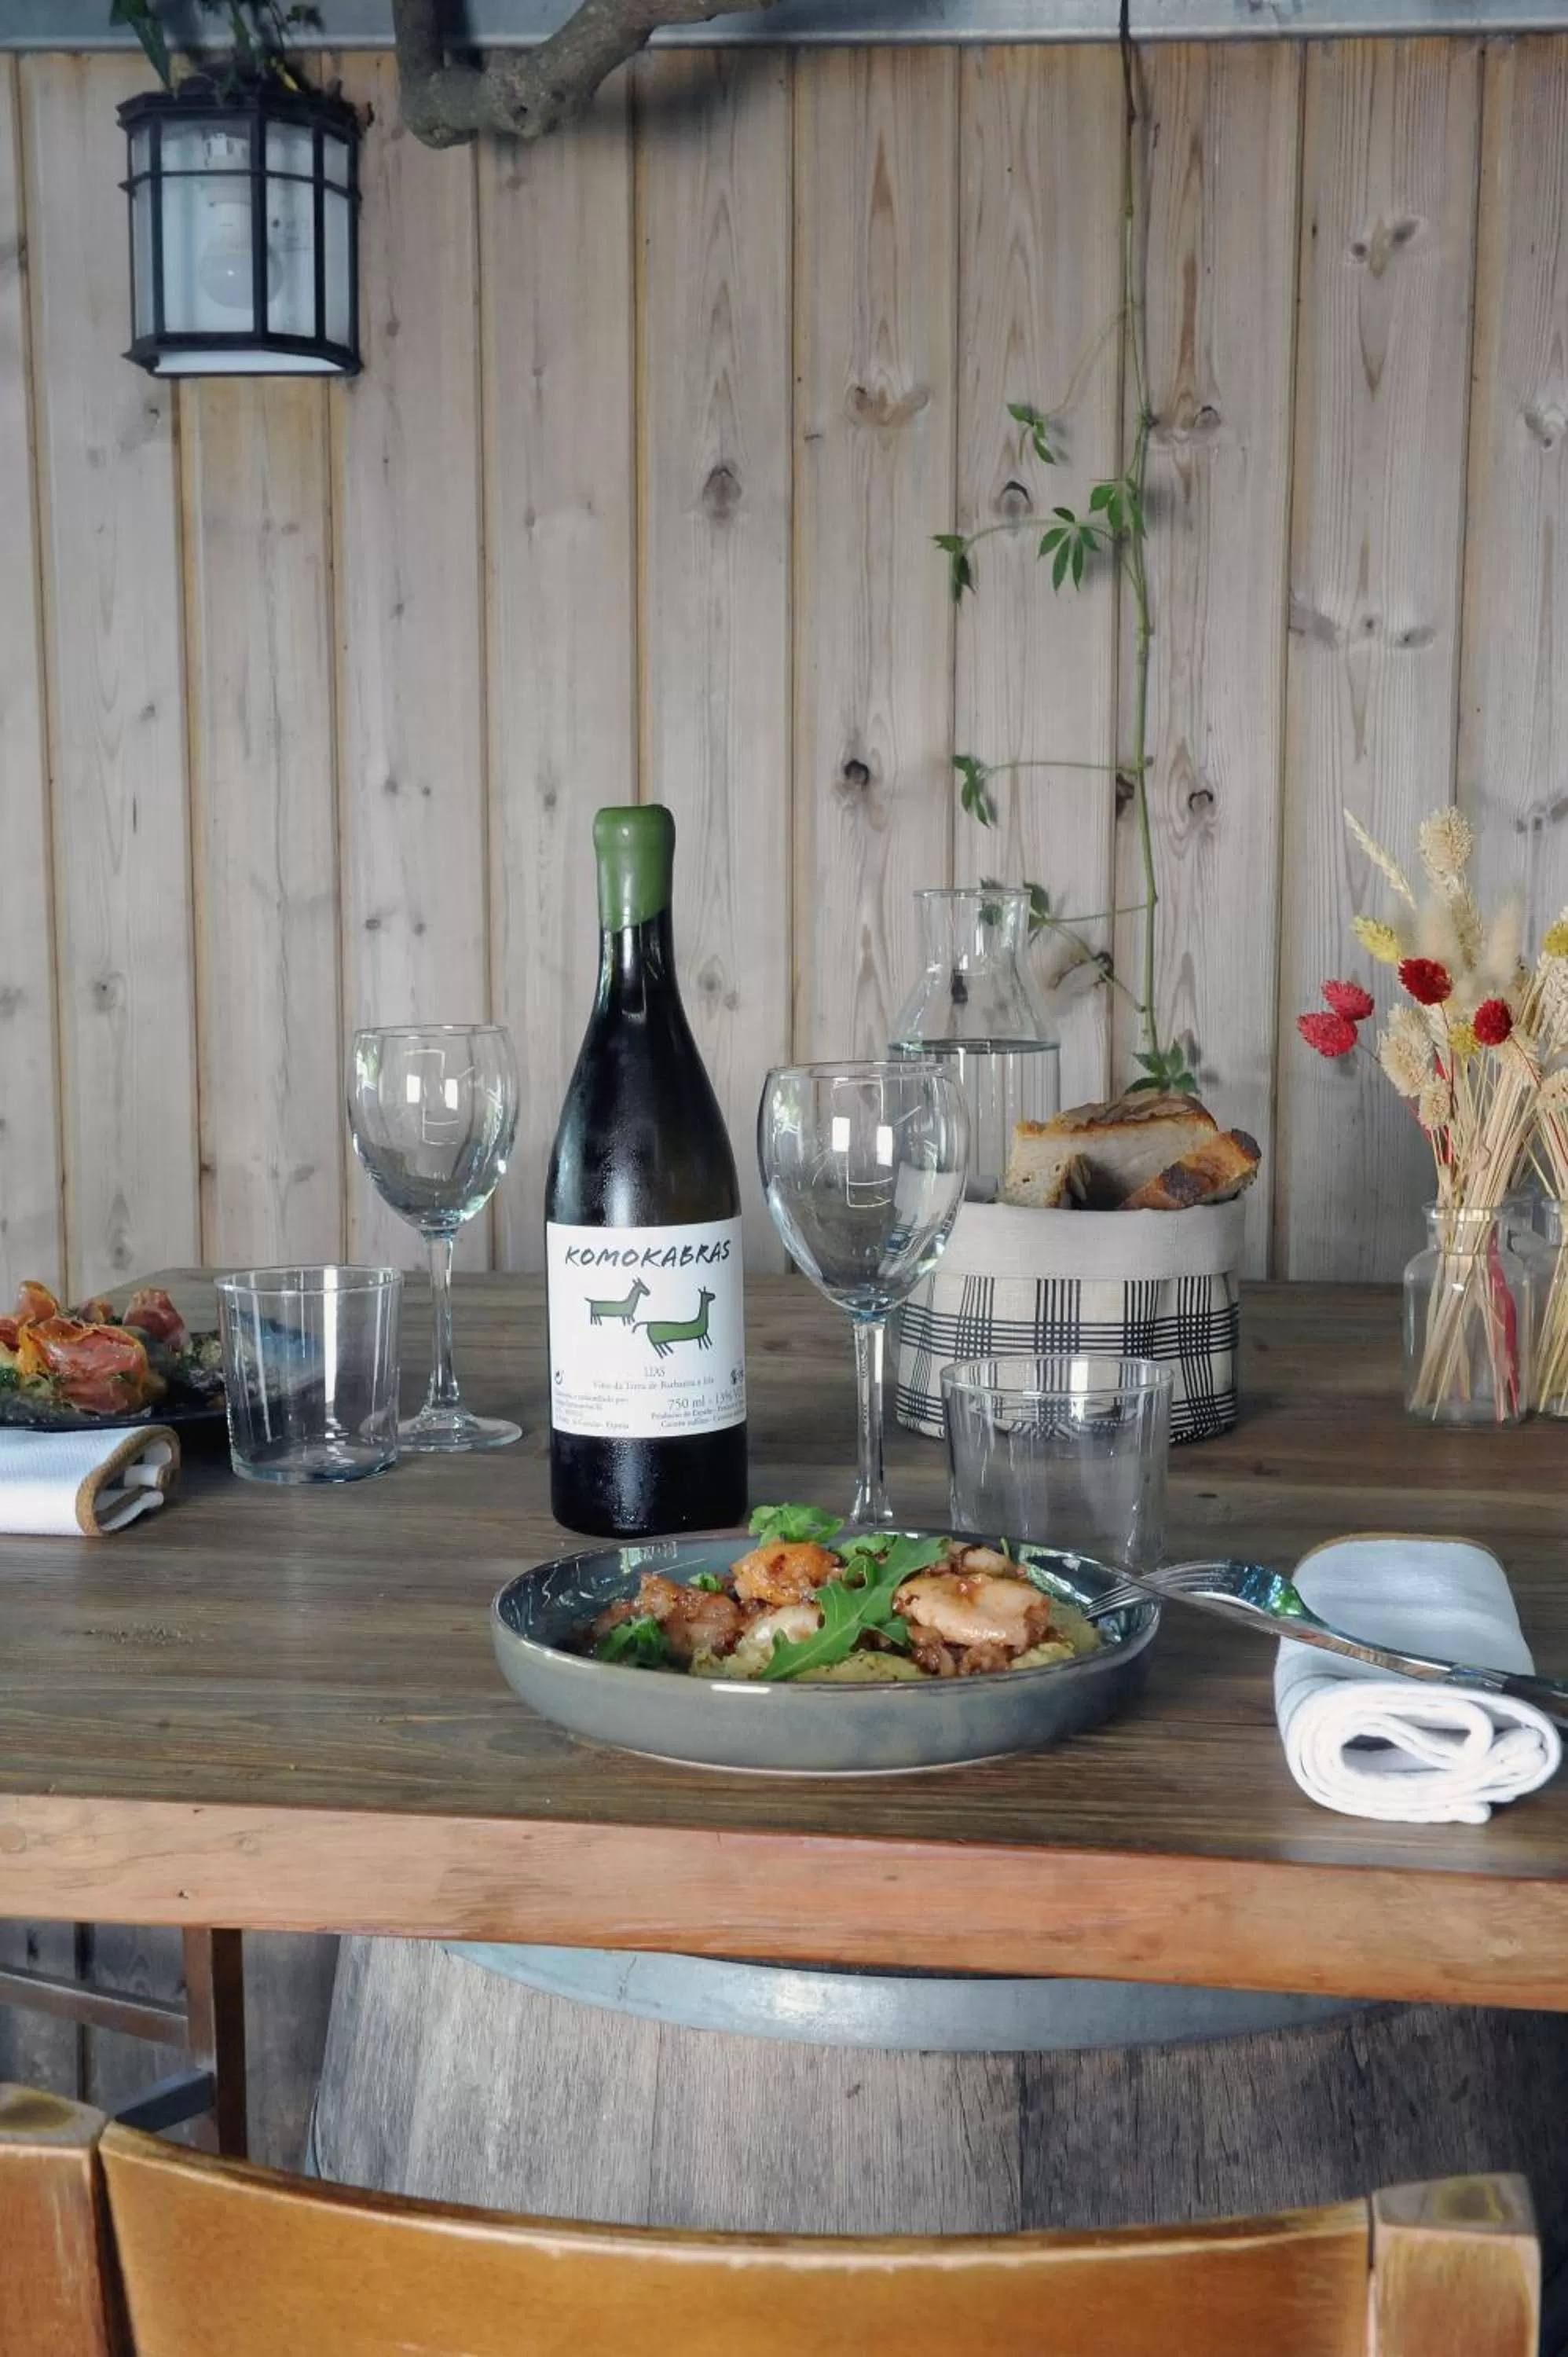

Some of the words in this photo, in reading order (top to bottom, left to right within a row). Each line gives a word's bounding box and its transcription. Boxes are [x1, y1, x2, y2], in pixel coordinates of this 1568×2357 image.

[566, 1239, 731, 1267] KOMOKABRAS
[668, 1398, 689, 1412] 750
[692, 1395, 705, 1409] ml
